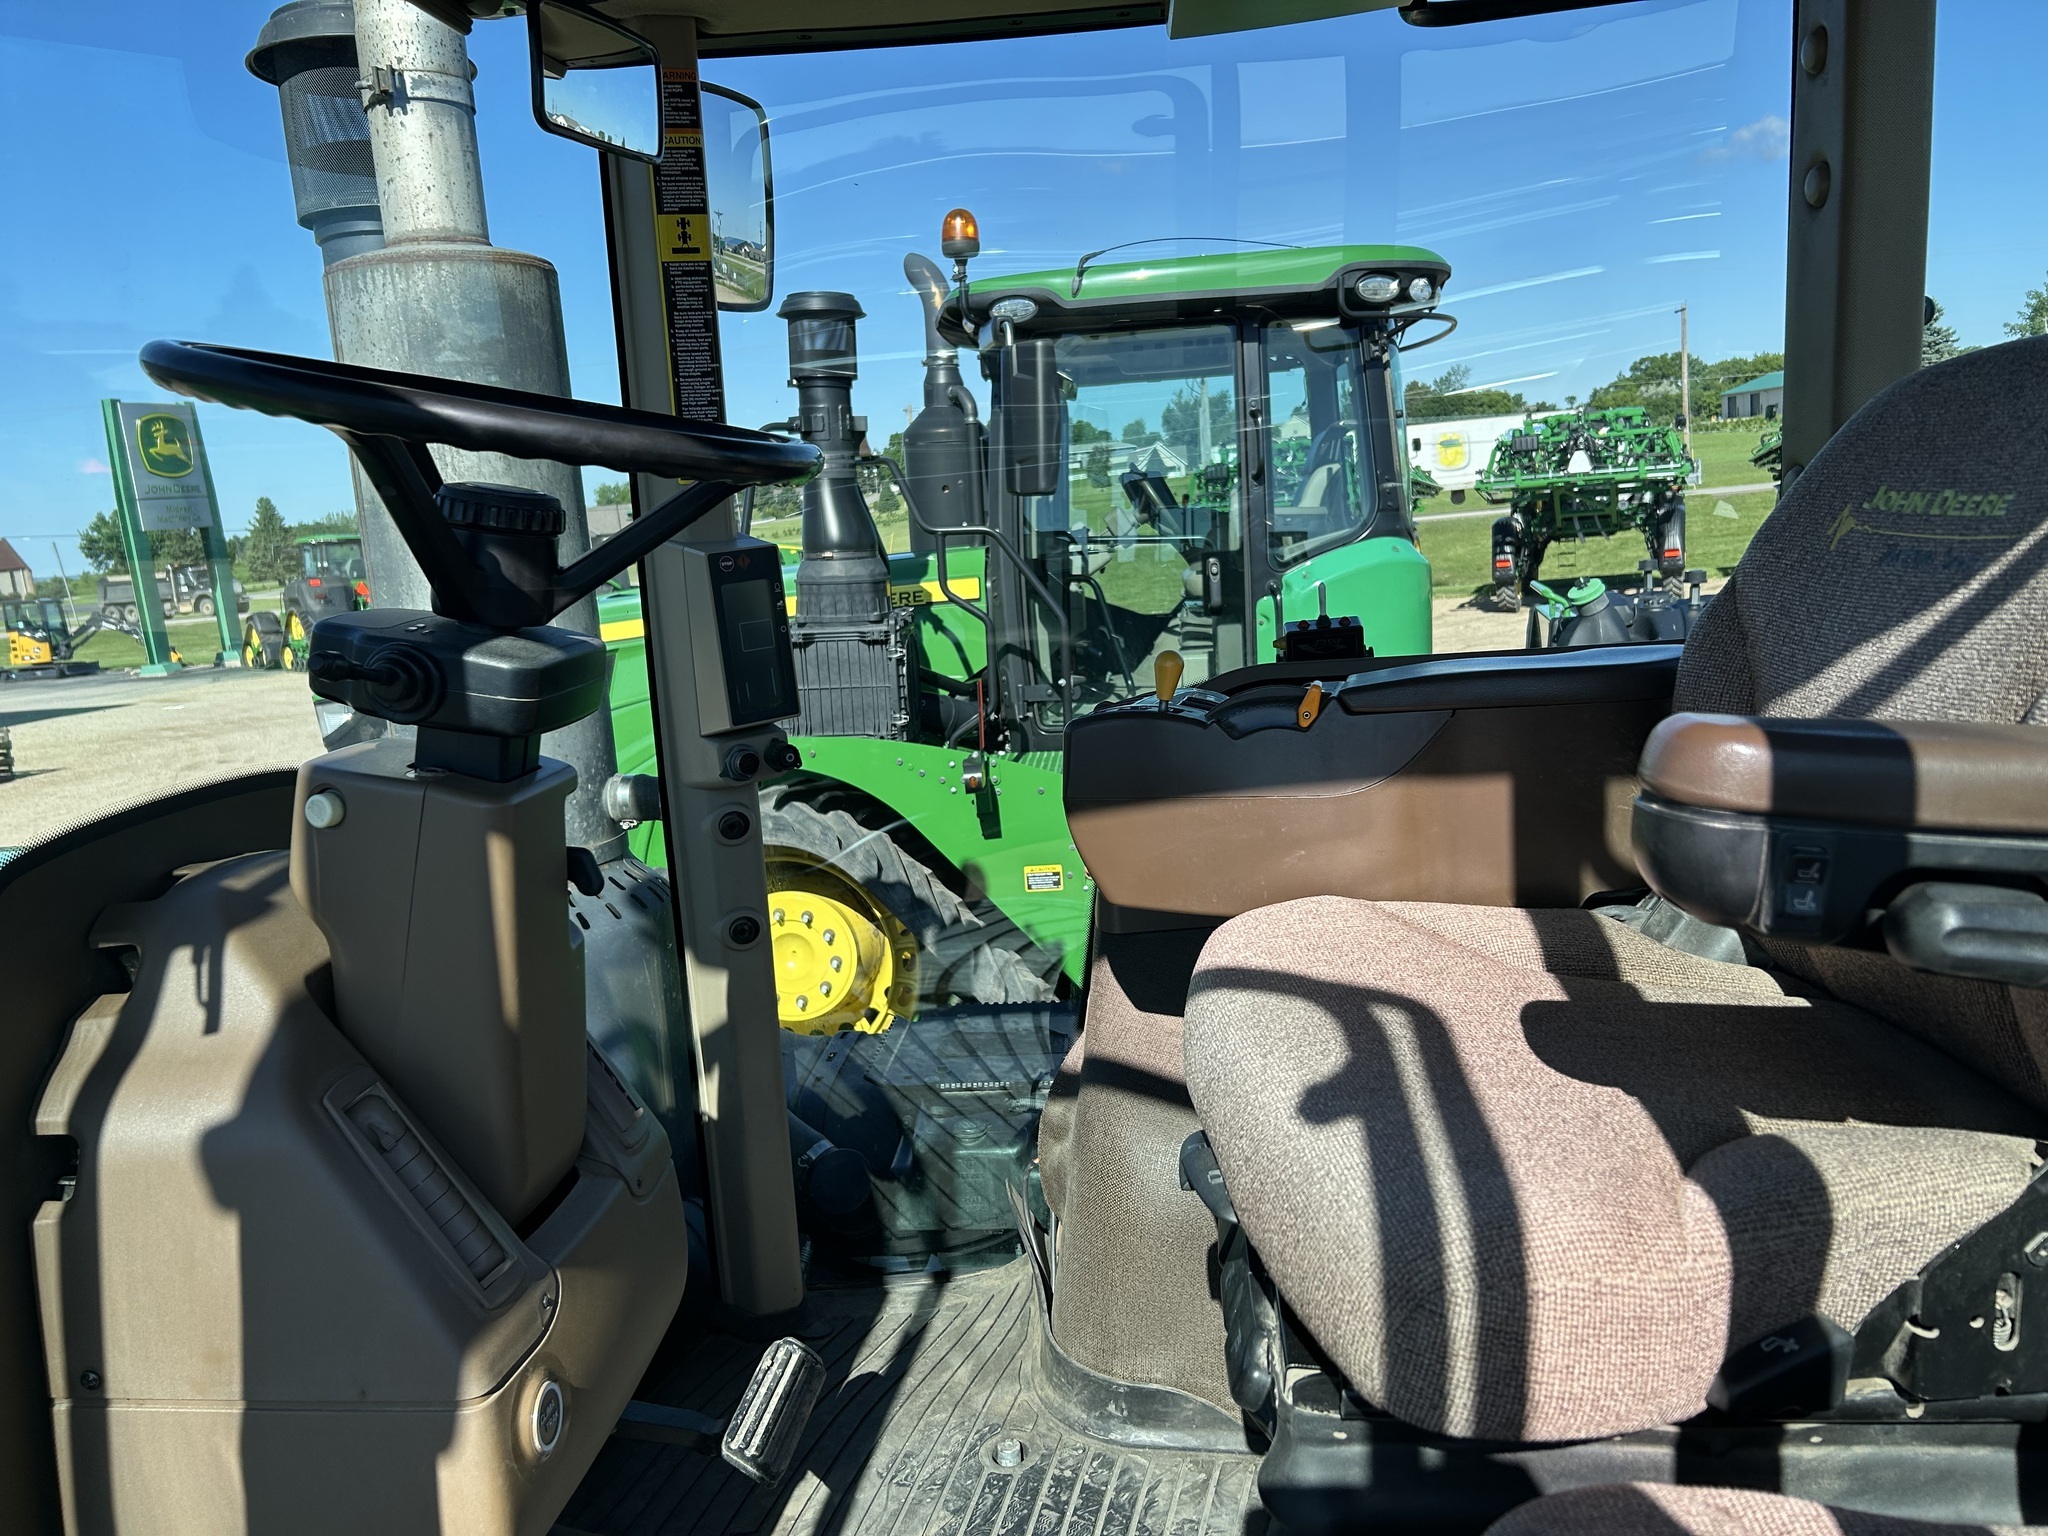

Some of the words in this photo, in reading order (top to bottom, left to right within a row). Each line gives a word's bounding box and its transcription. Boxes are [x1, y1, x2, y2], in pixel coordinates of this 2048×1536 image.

[663, 72, 696, 80] ARNING
[145, 485, 172, 494] JOHN
[173, 484, 201, 493] DEERE
[1862, 484, 1931, 514] JOHN
[1929, 489, 2016, 517] DEERE
[891, 590, 924, 605] ERE
